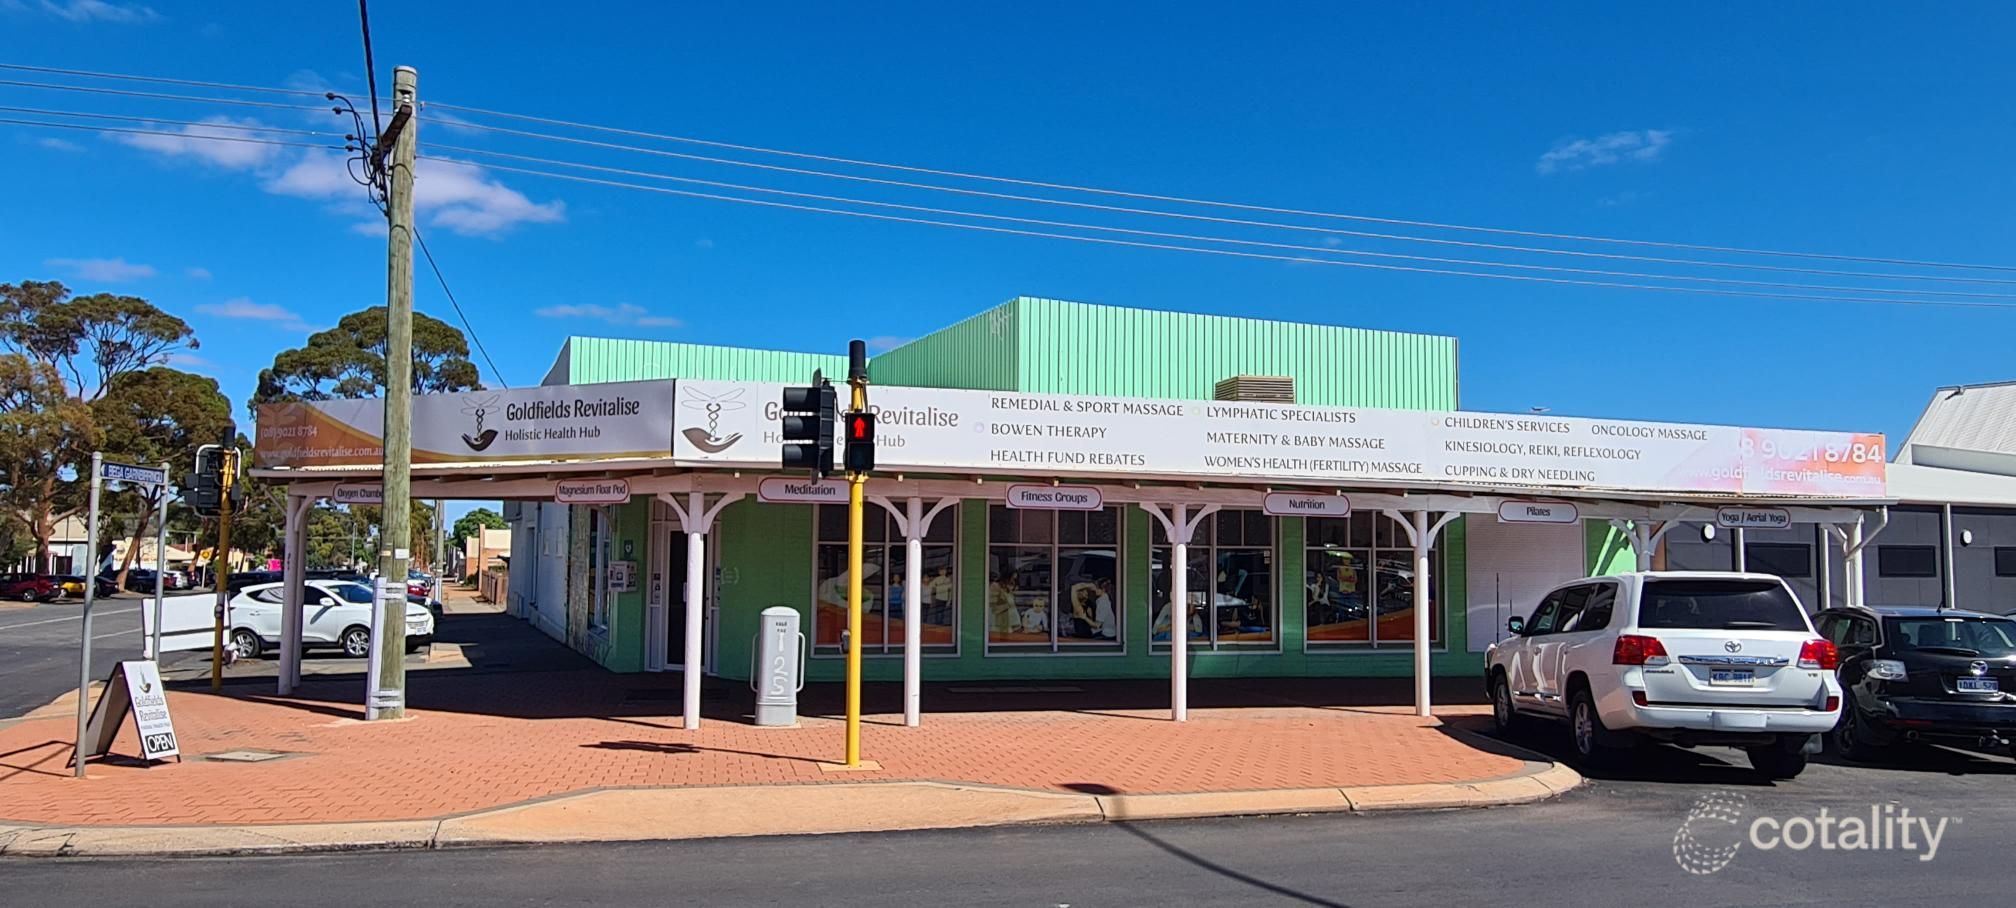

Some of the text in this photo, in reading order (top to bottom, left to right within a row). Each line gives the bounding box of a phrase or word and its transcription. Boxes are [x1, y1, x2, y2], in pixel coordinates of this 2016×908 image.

[506, 397, 640, 420] Goldfields Revitalise
[991, 398, 1184, 416] REMEDIAL & SPORT MASSAGE
[1206, 406, 1356, 423] LYMPHATIC SPECIALISTS
[868, 404, 959, 427] Revitalise
[505, 426, 601, 440] Holistic Health Hub
[991, 424, 1107, 438] BOWEN THERAPY
[1444, 416, 1570, 434] CHILDREN'S SERVICES
[1591, 424, 1708, 441] ONCOLOGY MASSAGE
[876, 434, 906, 448] Hub
[1206, 432, 1385, 450] MATERNITY & BABY MASSAGE
[990, 450, 1145, 466] HEALTH FUND REBATES
[1444, 440, 1641, 460] KINESIOLOGY, REIKI, REFLEXOLOGY
[1824, 443, 1882, 464] 8784
[108, 465, 124, 478] BEGA
[1204, 455, 1423, 474] WOMEN'S HEALTH (FERTILITY) MASSAGE
[1444, 464, 1596, 482] CUPPING & DRY NEEDLING
[338, 488, 358, 499] Oxygen
[560, 484, 626, 497] Magnesium Float Pod
[784, 484, 836, 496] Meditation
[1022, 490, 1088, 504] Fitness Groups
[1289, 499, 1325, 509] Nutrition
[1526, 506, 1550, 516] Pilates
[1722, 512, 1740, 524] Yoga
[1746, 512, 1766, 522] Aerial
[1768, 513, 1786, 524] Yoga
[148, 733, 174, 752] OPEN
